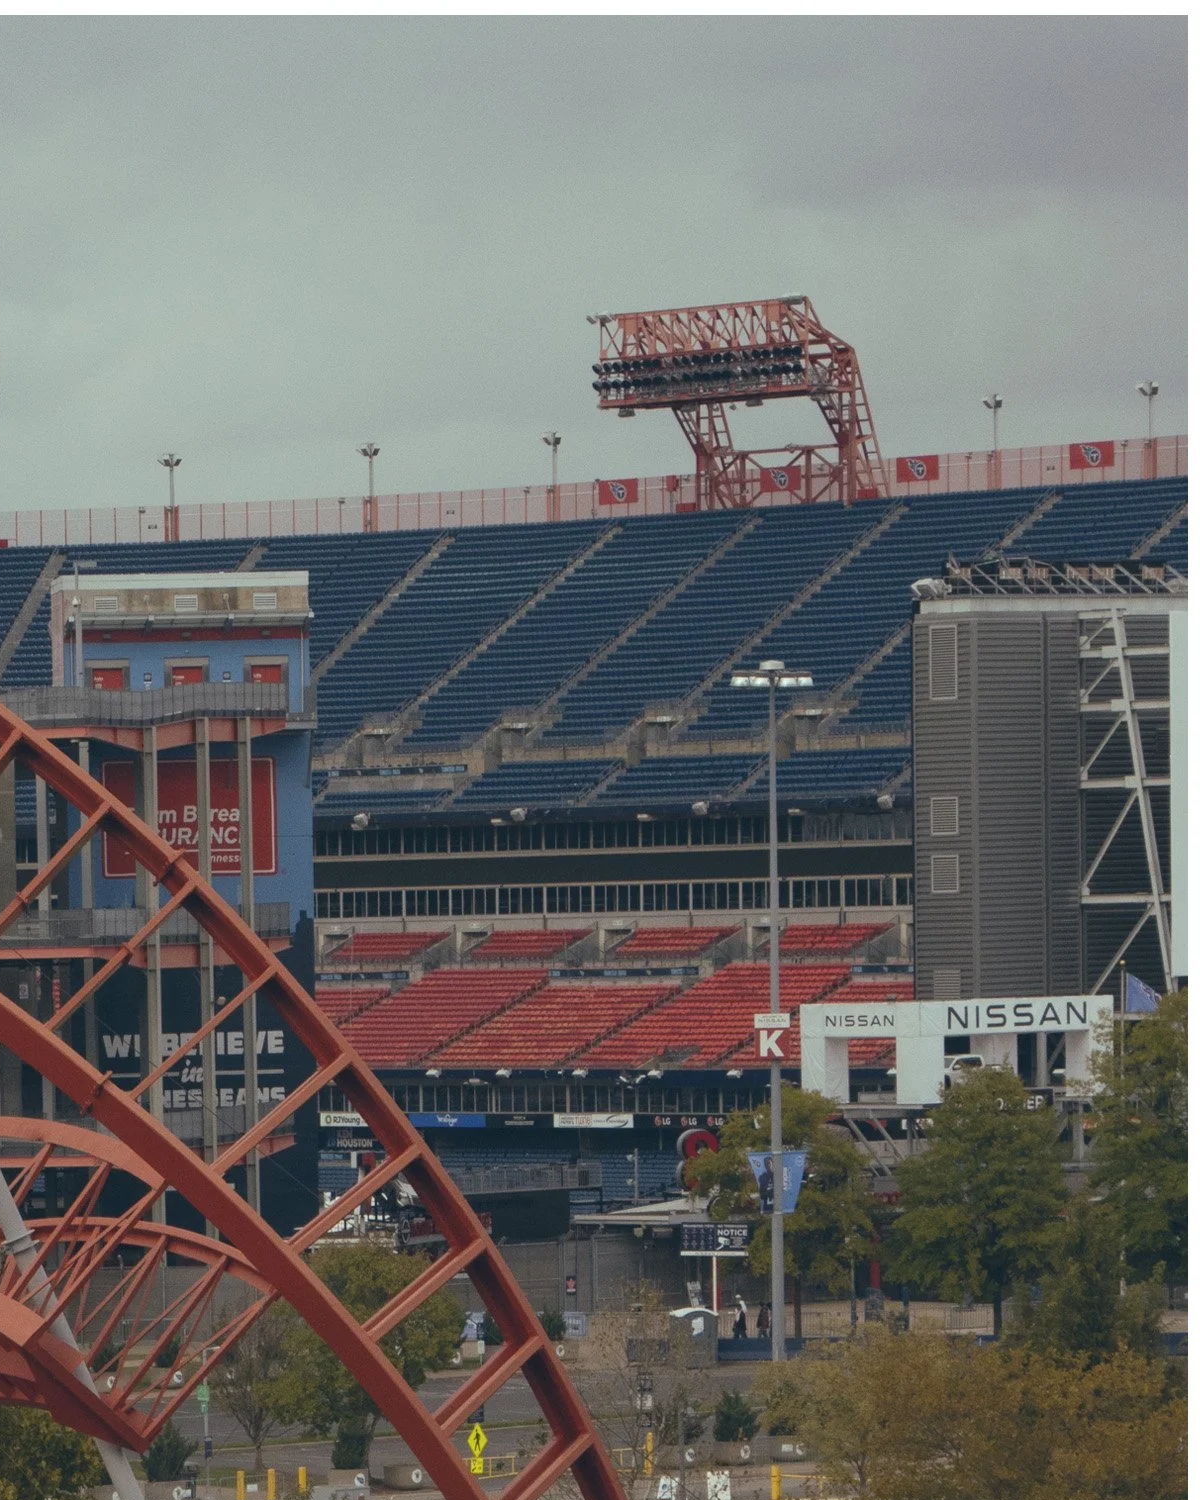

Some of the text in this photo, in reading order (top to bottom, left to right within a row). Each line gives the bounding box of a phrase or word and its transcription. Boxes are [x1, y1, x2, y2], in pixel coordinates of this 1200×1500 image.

[947, 1002, 1087, 1029] NISSAN
[825, 1015, 895, 1028] NISSAN
[759, 1030, 785, 1057] K
[662, 1117, 671, 1125] LG
[689, 1117, 698, 1125] LG
[715, 1117, 724, 1125] LG
[337, 1139, 373, 1148] HOUSTON
